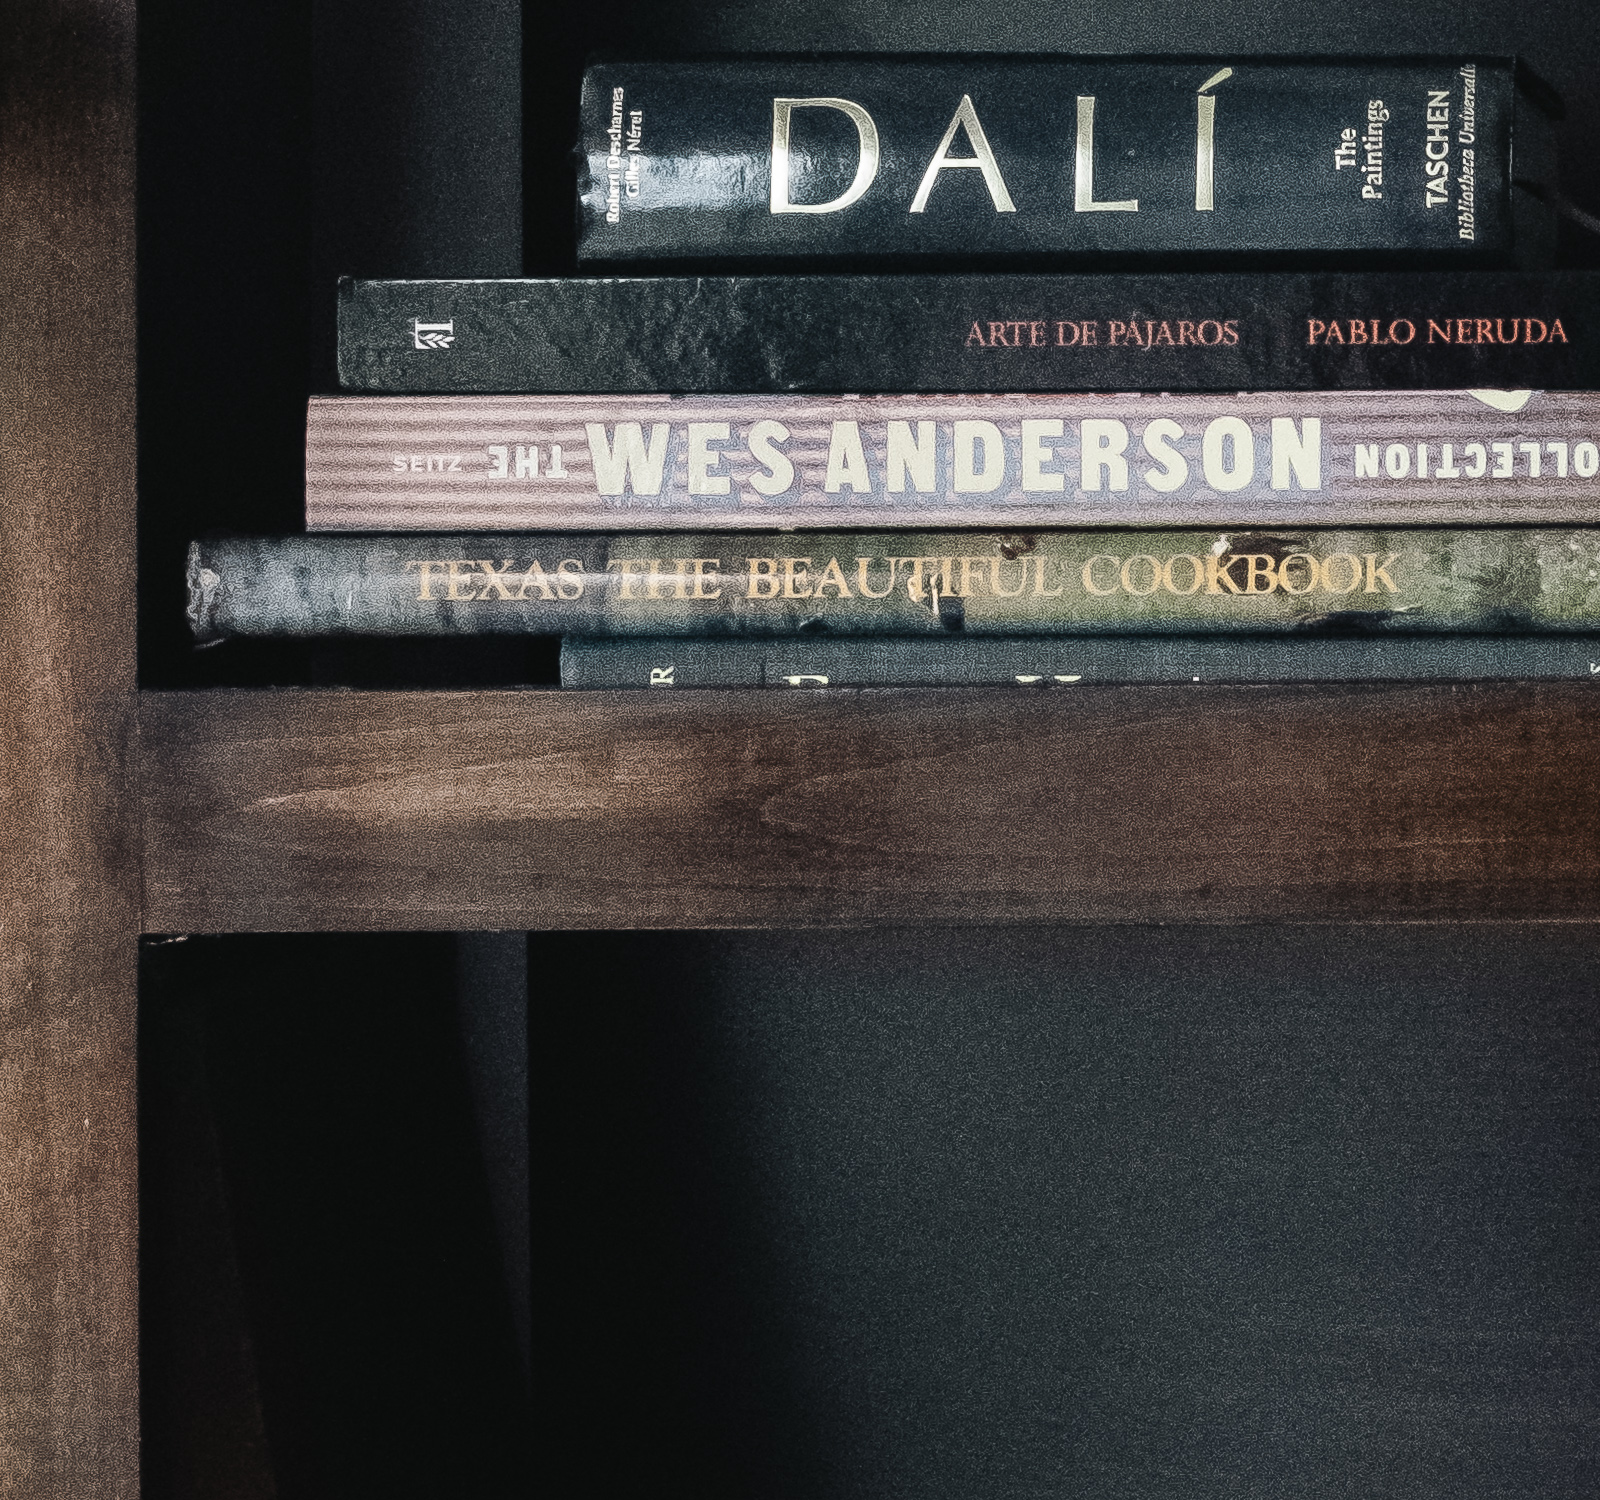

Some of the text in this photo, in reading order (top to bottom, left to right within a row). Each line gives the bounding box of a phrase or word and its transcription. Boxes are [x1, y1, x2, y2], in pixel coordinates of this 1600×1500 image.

[770, 66, 1233, 215] DALÍ
[1334, 128, 1356, 170] The
[1361, 99, 1390, 199] Paintings
[1426, 90, 1450, 208] TASCHEN
[1457, 149, 1475, 241] Bibliotheca
[965, 310, 1568, 350] ARTE DE PÁJAROS PABLO NERUDA
[393, 454, 462, 472] SEITZ
[488, 444, 568, 479] THE
[584, 420, 796, 497] WES
[822, 417, 1321, 496] ANDERSON
[407, 553, 1402, 600] TEXAS THE BEAUTIFUL COOKBOOK
